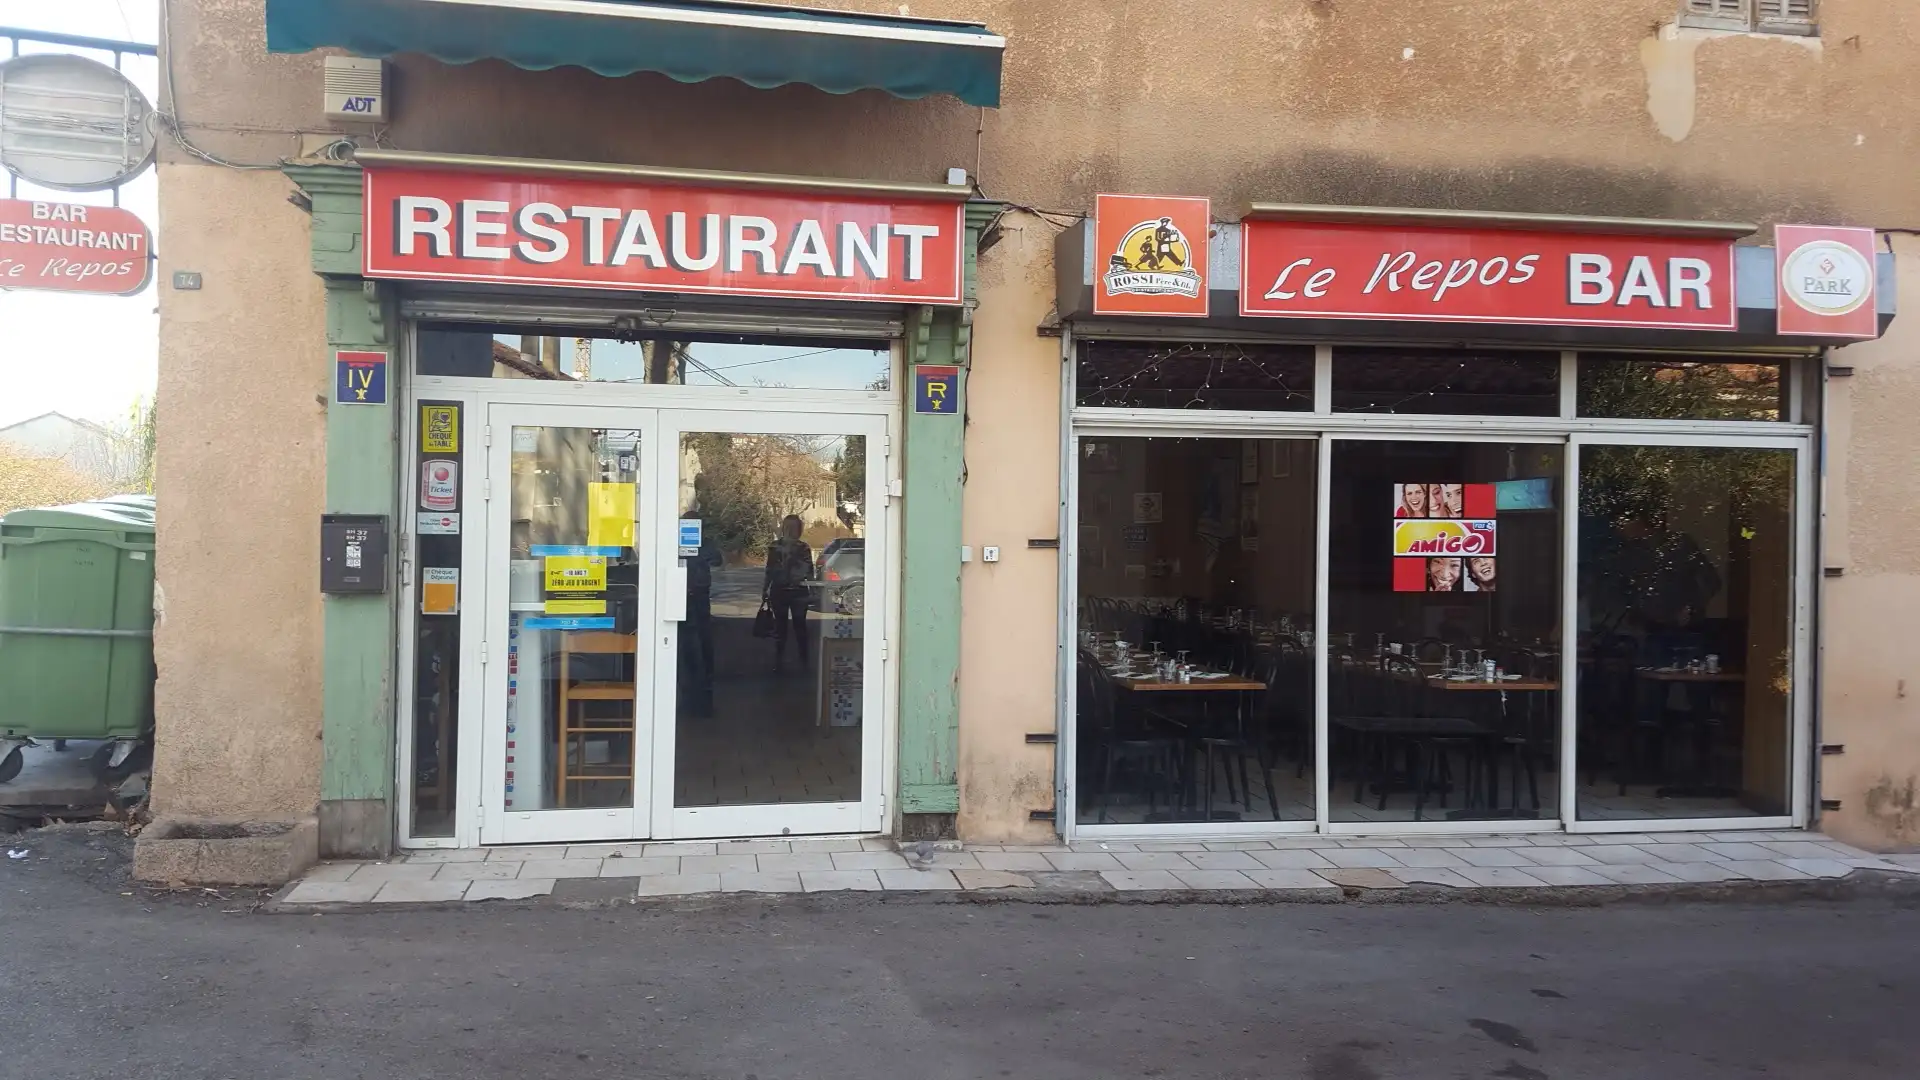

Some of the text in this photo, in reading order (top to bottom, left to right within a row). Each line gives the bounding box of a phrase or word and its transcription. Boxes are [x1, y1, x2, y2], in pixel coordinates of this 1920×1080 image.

[341, 96, 376, 112] ADT
[32, 201, 87, 223] BAR
[394, 195, 940, 281] RESTAURANT
[40, 257, 133, 281] Repos
[1113, 274, 1154, 288] ROSSI
[1264, 251, 1712, 309] Le Repos BAR
[1803, 276, 1852, 293] PARK
[927, 382, 947, 398] R
[434, 440, 453, 448] TABLE
[430, 486, 453, 494] Ticket
